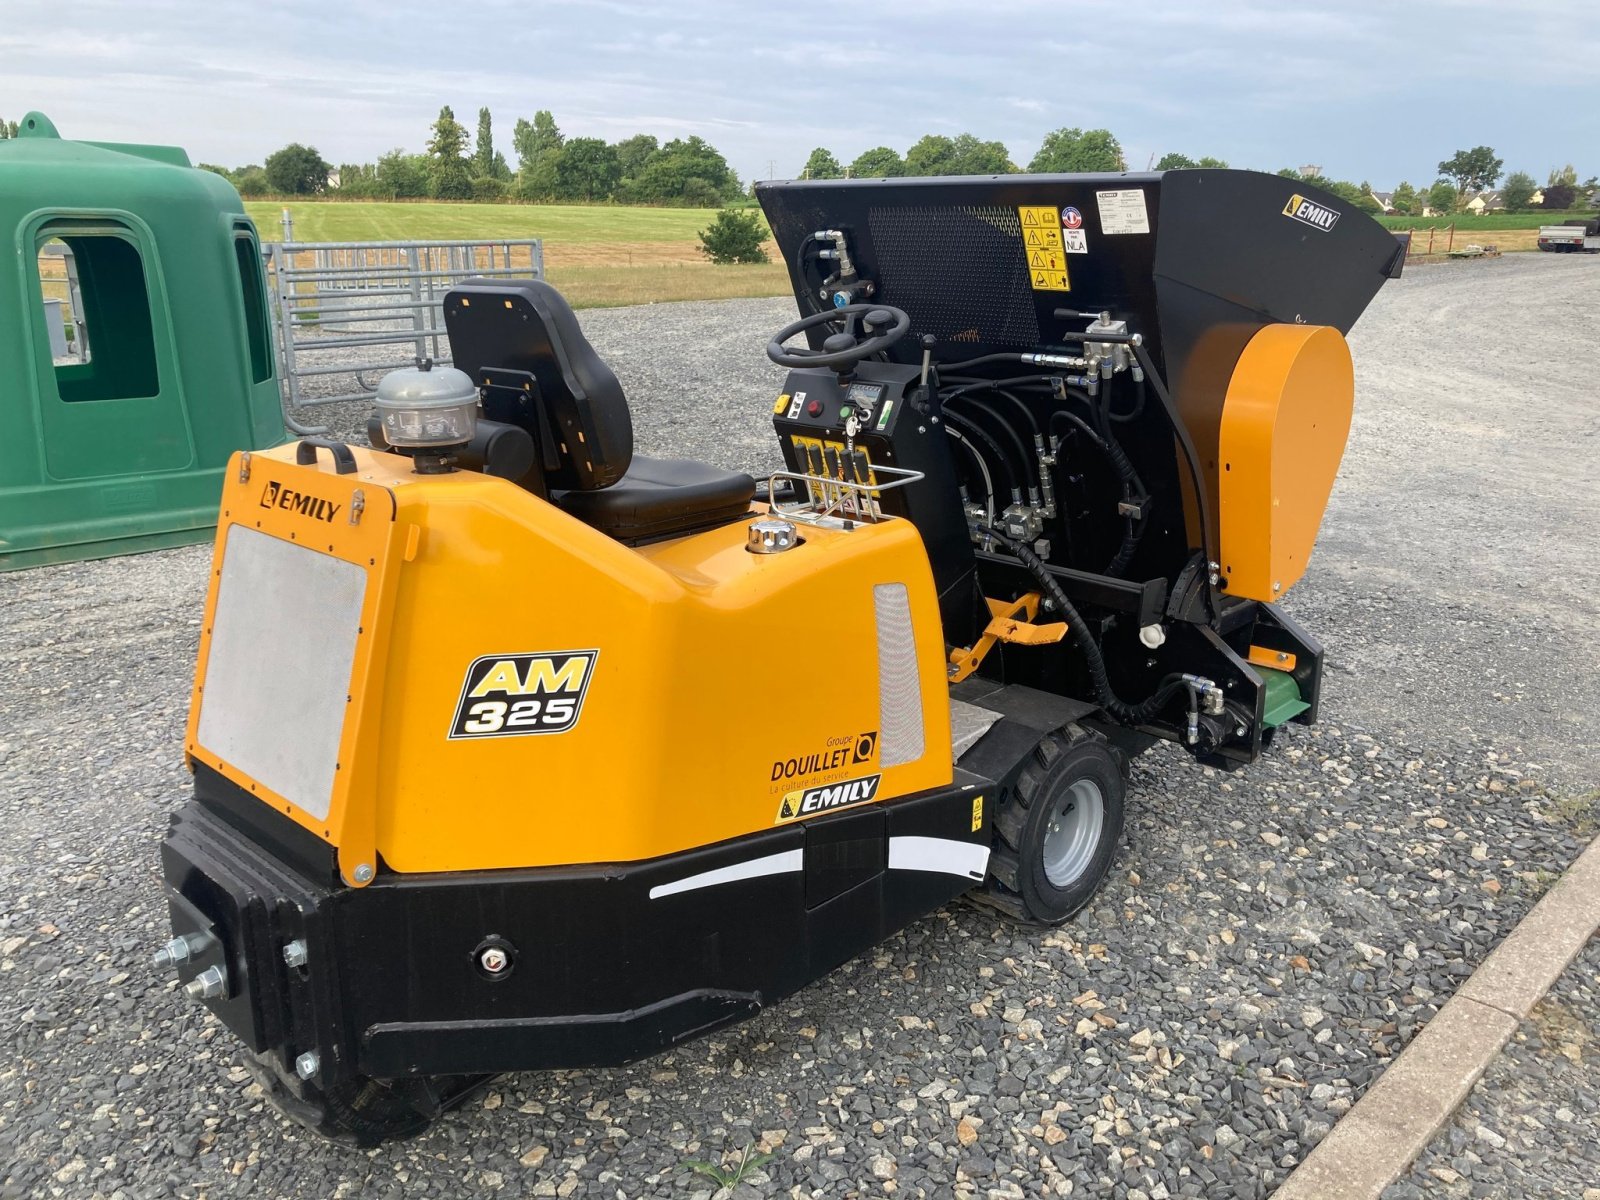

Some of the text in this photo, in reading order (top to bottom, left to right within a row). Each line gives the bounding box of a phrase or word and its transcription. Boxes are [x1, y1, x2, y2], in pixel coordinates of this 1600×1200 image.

[1296, 202, 1337, 228] EMILY
[1066, 240, 1086, 251] NLA
[279, 489, 342, 523] EMILY
[467, 656, 589, 698] AM
[464, 698, 577, 733] 325
[826, 735, 853, 747] Groupe
[769, 770, 849, 794] La culture du service
[771, 748, 851, 782] DOUILLET
[802, 777, 878, 813] EMILY
